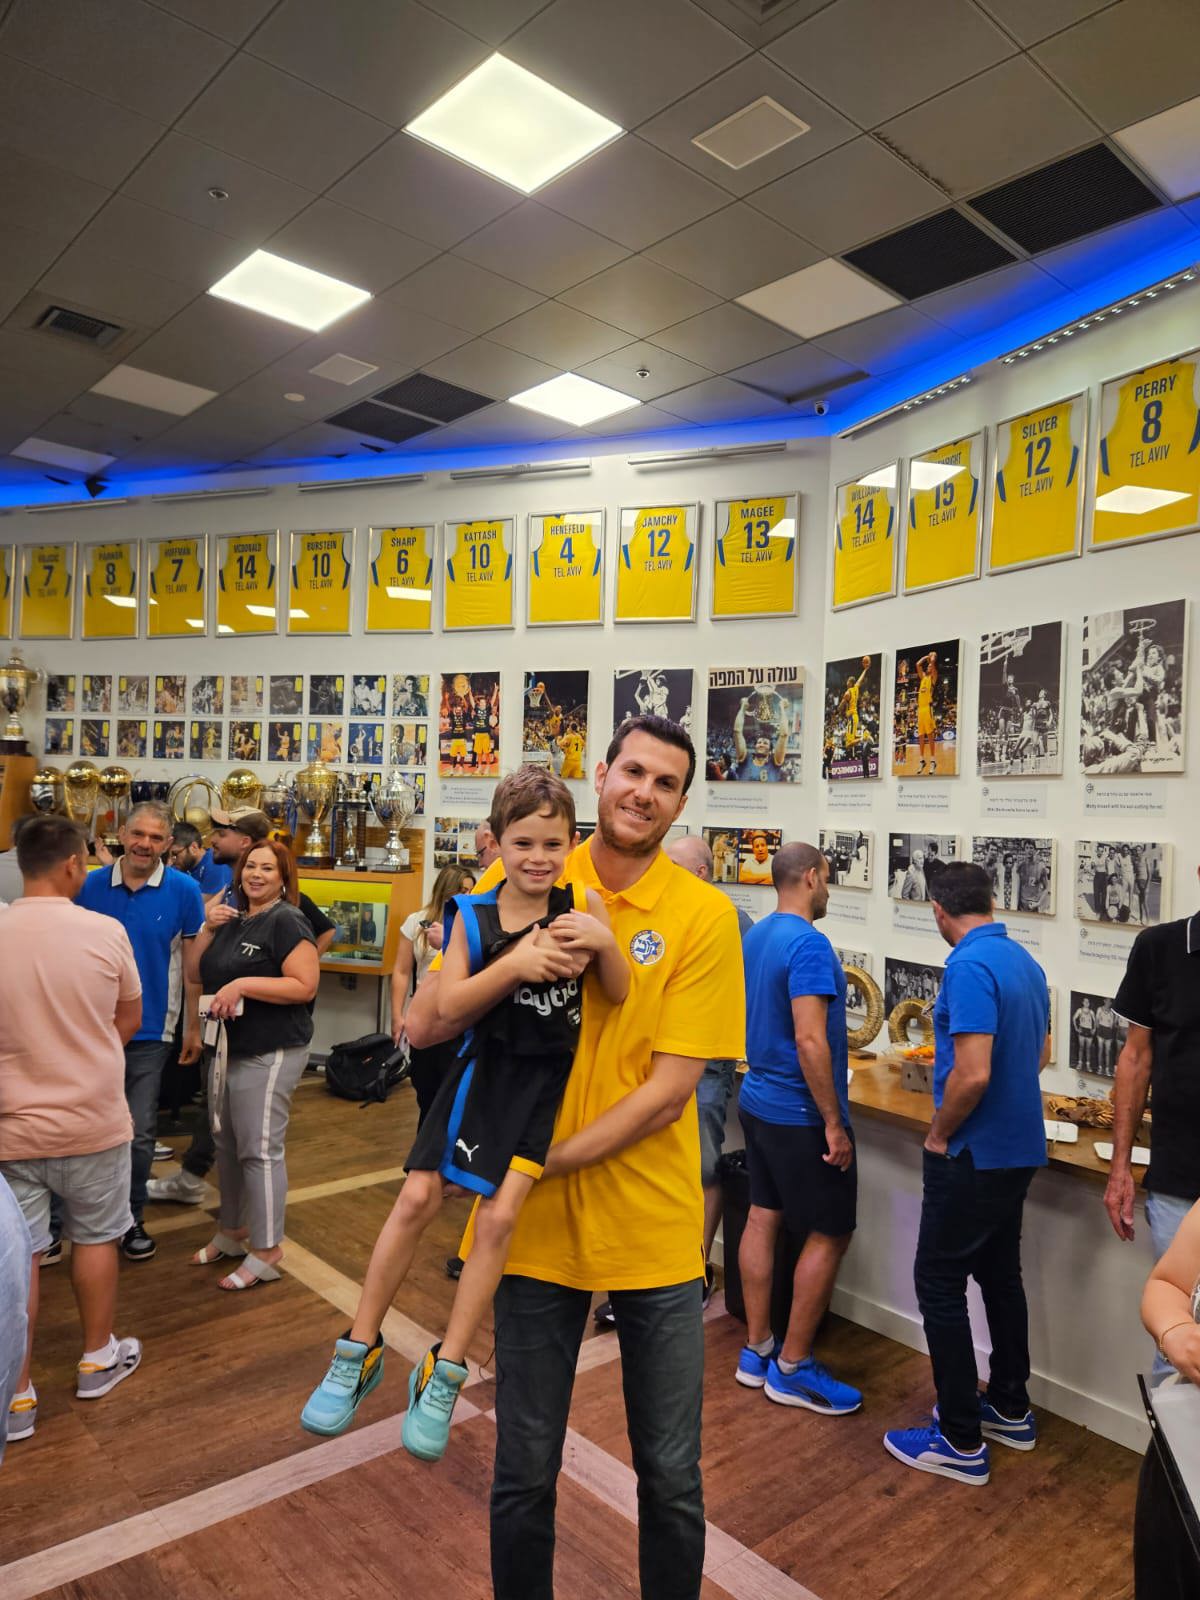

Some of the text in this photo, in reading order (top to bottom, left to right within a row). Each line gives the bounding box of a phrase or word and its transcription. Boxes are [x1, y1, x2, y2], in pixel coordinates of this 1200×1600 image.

[1134, 374, 1177, 402] PERRY
[1022, 415, 1058, 439] SILVER
[1141, 400, 1163, 444] 8
[1025, 436, 1052, 478] 12
[1130, 444, 1170, 468] TEL AVIV
[935, 480, 954, 510] 15
[1020, 476, 1054, 498] TEL AVIV
[642, 514, 678, 528] JAMCHY
[740, 506, 774, 519] MAGEE
[854, 498, 875, 534] 14
[928, 507, 957, 526] TEL AVIV
[390, 537, 416, 548] SHARP
[464, 530, 497, 542] KATTASH
[648, 528, 671, 558] 12
[744, 520, 770, 550] 13
[852, 532, 876, 549] TEL AVIV
[396, 549, 409, 574] 6
[470, 544, 490, 570] 10
[560, 537, 575, 564] 4
[740, 550, 773, 563] TEL AVIV
[43, 565, 54, 586] 7
[106, 563, 116, 585] 8
[172, 558, 184, 582] 7
[236, 554, 256, 580] 14
[312, 552, 330, 578] 10
[554, 566, 582, 578] TEL AVIV
[644, 559, 672, 572] TEL AVIV
[235, 582, 258, 592] TEL AVIV
[310, 580, 333, 590] TEL AVIV
[390, 577, 415, 586] TEL AVIV
[467, 571, 494, 582] TEL AVIV
[710, 666, 797, 687] עולה על המפה
